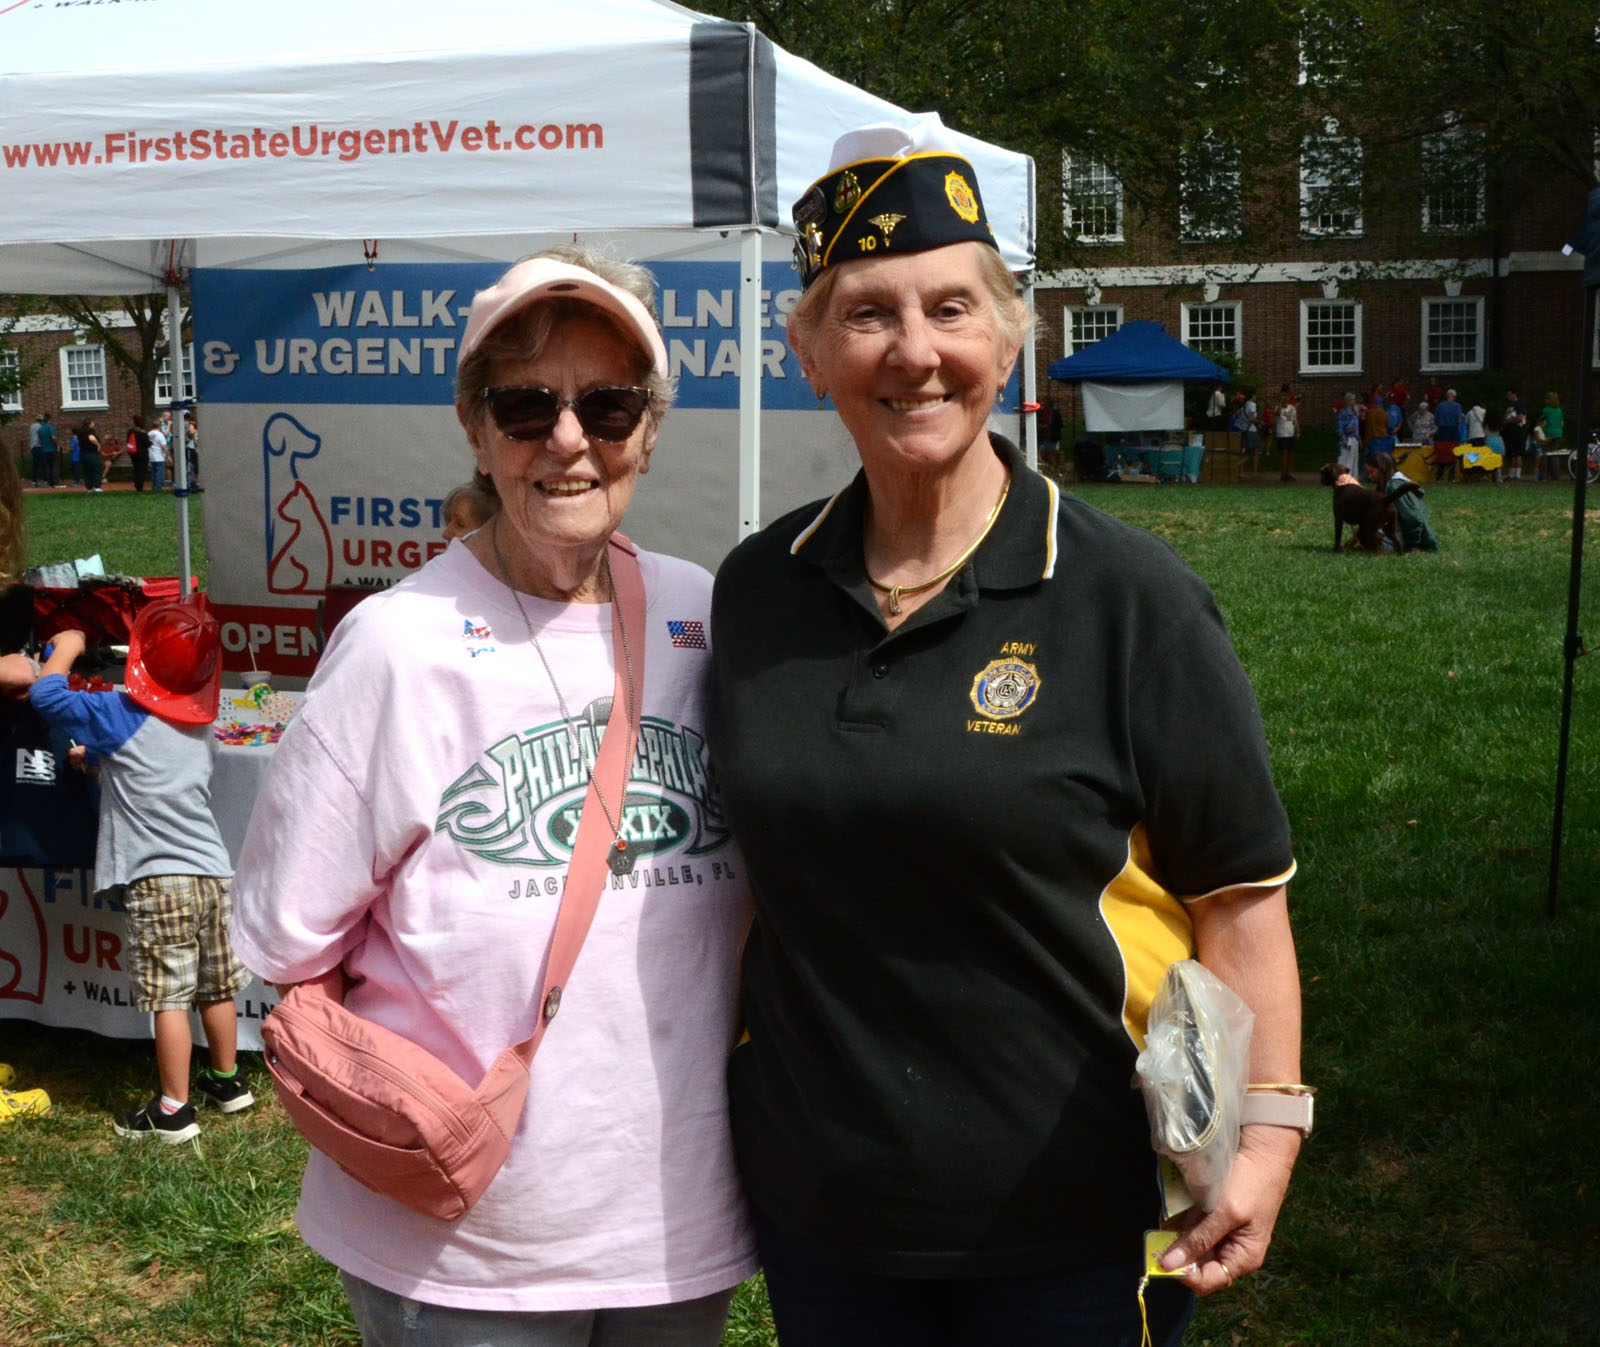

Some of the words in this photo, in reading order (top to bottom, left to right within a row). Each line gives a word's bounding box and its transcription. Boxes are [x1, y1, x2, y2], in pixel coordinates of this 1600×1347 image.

[2, 119, 604, 169] www.FirstStateUrgentVet.com
[858, 235, 877, 251] 10
[203, 340, 241, 375] &
[255, 337, 456, 376] URGENT
[330, 496, 444, 528] FIRST
[1000, 641, 1036, 656] ARMY
[967, 720, 1022, 735] VETERAN
